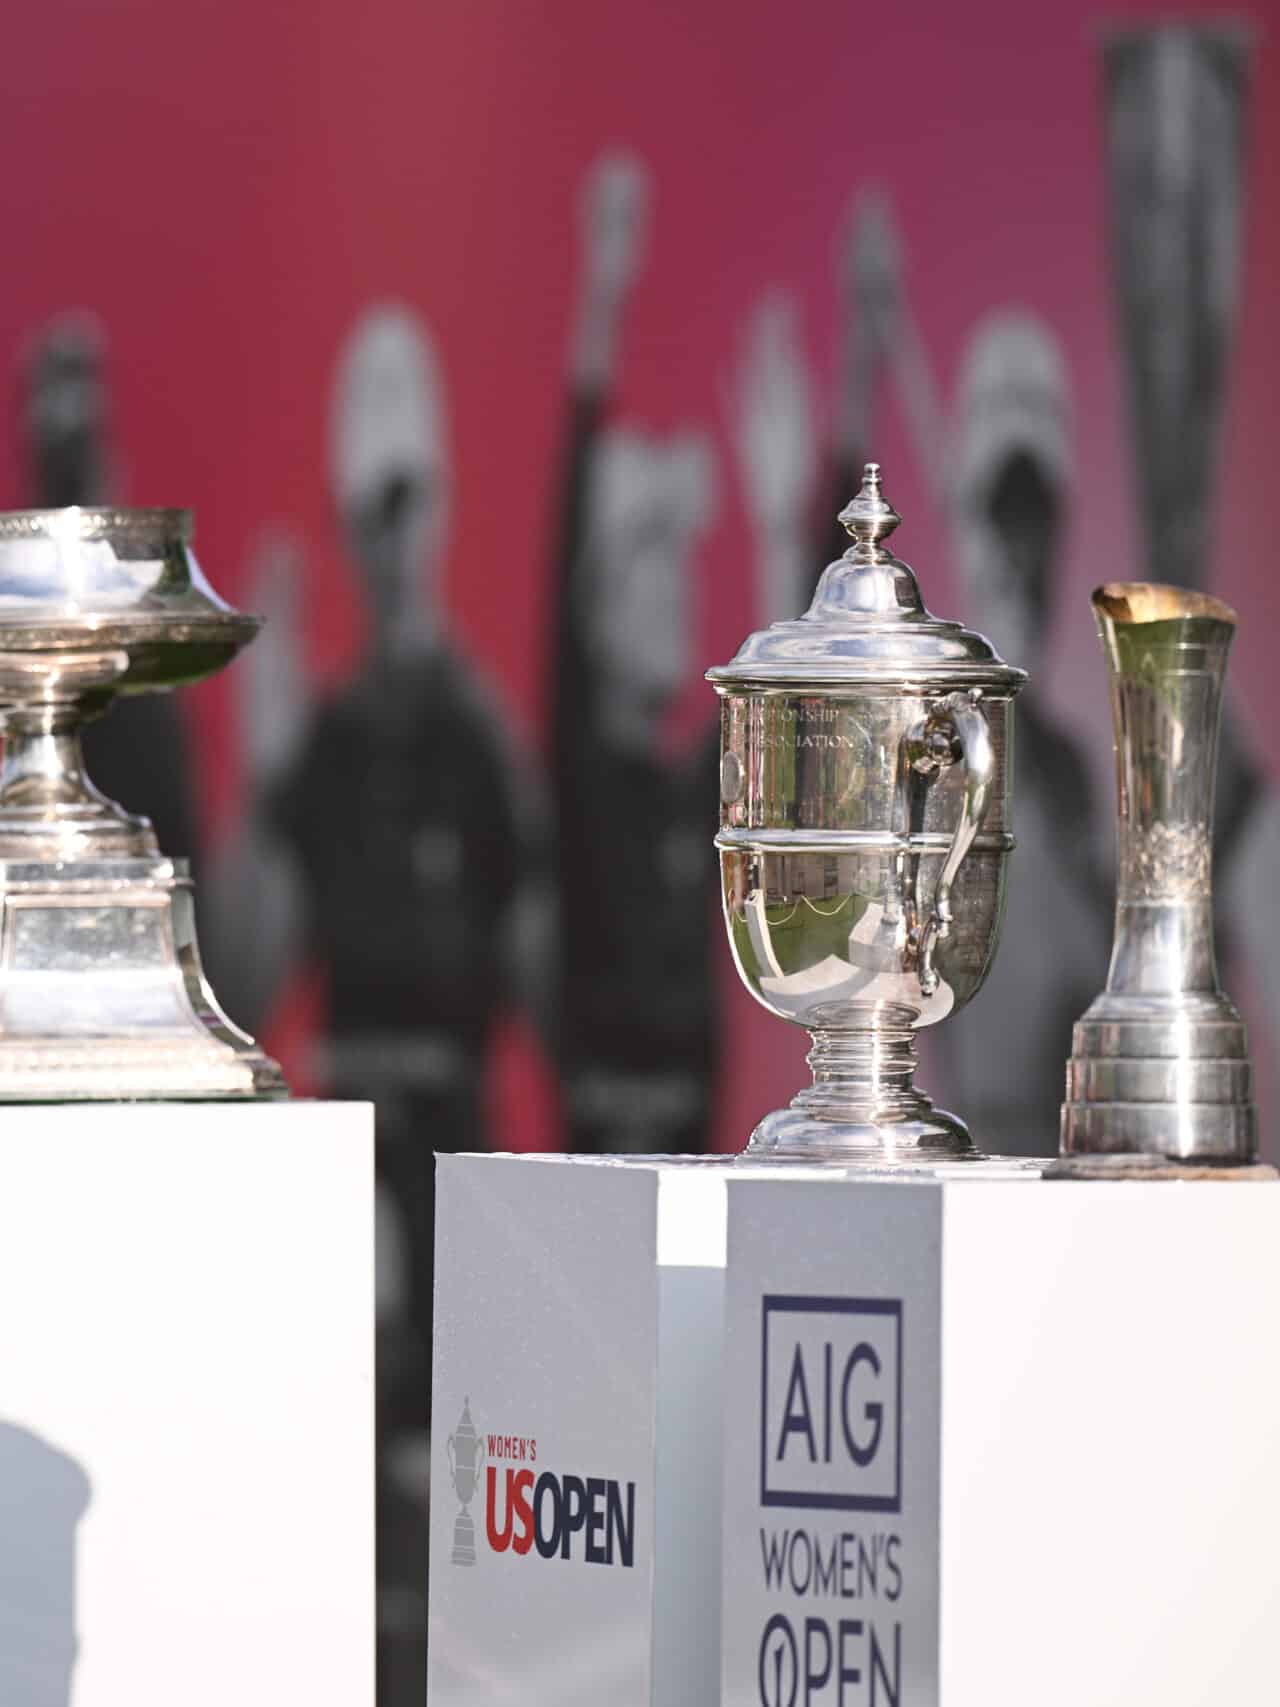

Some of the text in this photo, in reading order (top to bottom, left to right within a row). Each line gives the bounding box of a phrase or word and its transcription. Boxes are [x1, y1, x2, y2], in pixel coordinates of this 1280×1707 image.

[776, 1342, 884, 1467] AIG
[487, 1435, 537, 1462] WOMEN'S
[760, 1528, 902, 1601] WOMEN'S
